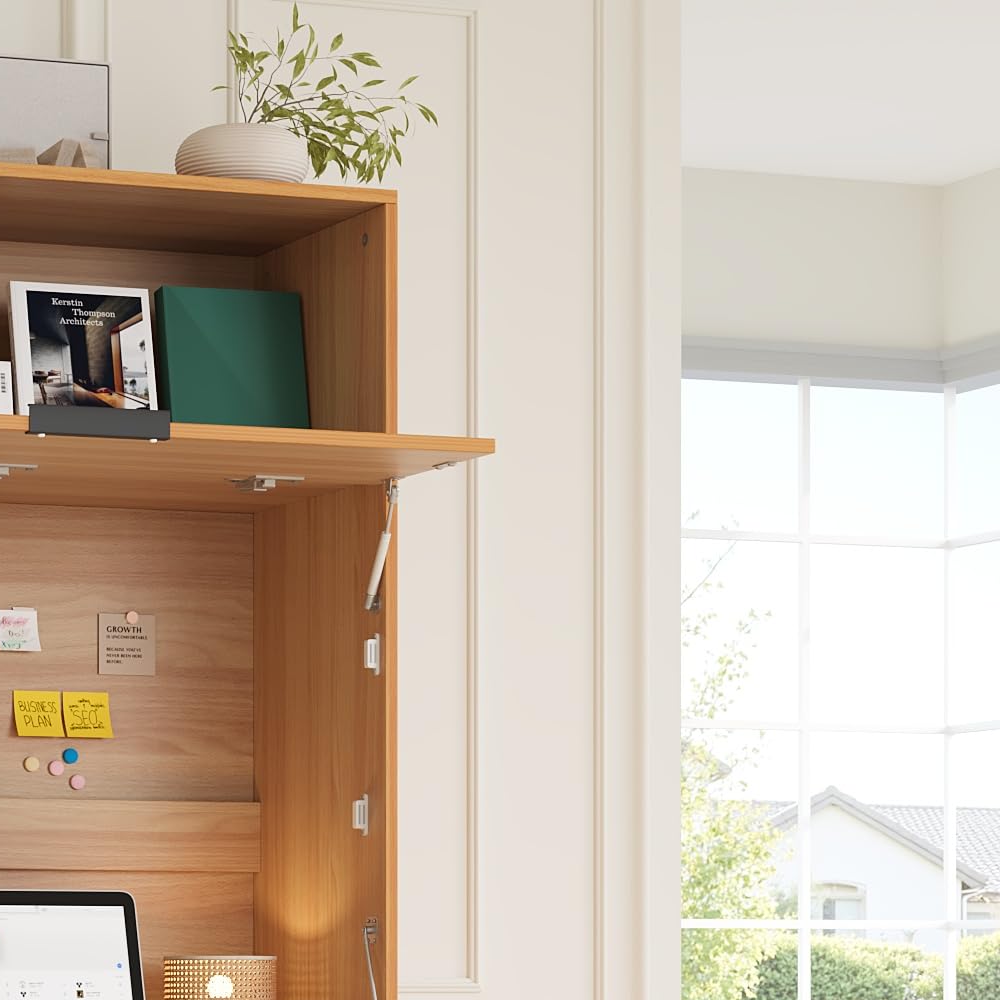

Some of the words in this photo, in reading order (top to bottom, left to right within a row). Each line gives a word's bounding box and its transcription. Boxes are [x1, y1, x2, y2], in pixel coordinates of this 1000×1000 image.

[51, 297, 83, 307] Kerstin
[72, 308, 116, 318] Thompson
[60, 317, 104, 326] Architects
[106, 625, 142, 634] GROWTH
[18, 700, 58, 714] BUSINESS
[24, 714, 52, 728] PLAN
[72, 709, 99, 726] SEO
